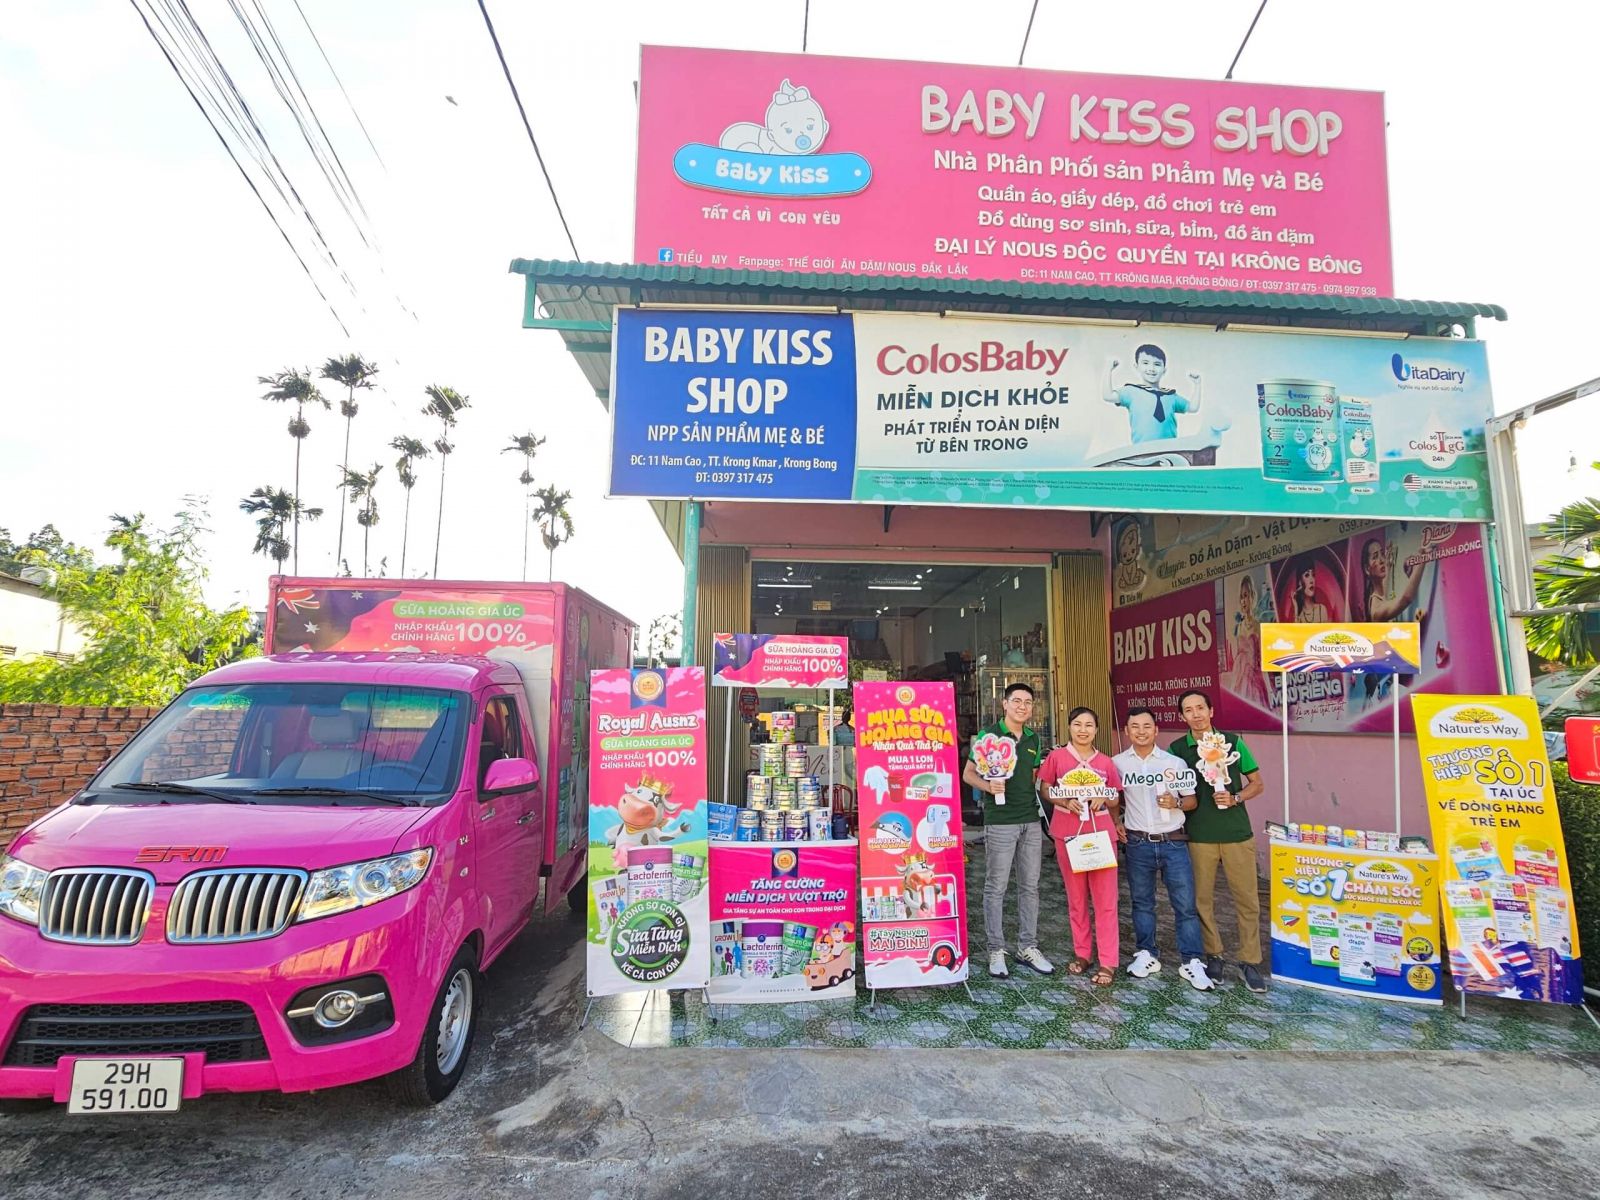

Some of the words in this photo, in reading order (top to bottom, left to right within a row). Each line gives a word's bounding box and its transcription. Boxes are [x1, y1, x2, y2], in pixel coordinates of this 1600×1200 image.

[921, 85, 1045, 140] BABY
[1070, 94, 1195, 149] KISS
[1214, 106, 1343, 157] SHOP
[716, 158, 772, 185] Baby
[780, 164, 829, 184] Kiss
[934, 150, 977, 171] Nhà
[987, 152, 1043, 175] Phân
[1051, 155, 1098, 178] Phối
[1104, 159, 1143, 181] sản
[1152, 161, 1215, 185] Phẩm
[1223, 167, 1255, 193] Mẹ
[1261, 171, 1286, 190] và
[1294, 172, 1323, 192] Bé
[978, 184, 1025, 203] Quần
[1031, 188, 1057, 206] áo,
[1102, 191, 1138, 211] dép,
[1144, 193, 1167, 210] đồ
[1173, 198, 1213, 213] chơi
[1220, 199, 1244, 215] trẻ
[1250, 204, 1276, 217] em
[702, 206, 728, 220] TẤT
[732, 205, 750, 221] CẢ
[757, 208, 771, 222] VÌ
[779, 213, 806, 224] CON
[812, 211, 840, 225] YÊU
[978, 210, 1004, 226] Đồ
[1010, 213, 1054, 233] dùng
[1059, 219, 1084, 231] sơ
[1089, 219, 1131, 235] sinh,
[1136, 220, 1175, 238] sữa,
[1180, 220, 1218, 240] bỉm,
[1250, 227, 1273, 242] ăn
[1277, 230, 1315, 247] dặm
[739, 256, 784, 269] Fanpage:
[934, 237, 968, 257] ĐẠI
[974, 236, 996, 255] LÝ
[1003, 241, 1057, 258] NOUS
[1063, 240, 1107, 264] ĐỘC
[1116, 244, 1187, 265] QUYỀN
[1194, 251, 1225, 270] TẠI
[1231, 252, 1300, 272] KRÔNG
[1308, 255, 1363, 275] BÔNG
[1051, 270, 1072, 279] NAM
[1075, 271, 1097, 282] CAO,
[1099, 272, 1111, 281] TT
[1285, 281, 1300, 291] 317
[1302, 282, 1317, 292] 475
[1324, 284, 1343, 293] 0974
[1345, 285, 1360, 295] 997
[644, 326, 744, 364] BABY
[753, 329, 832, 366] KISS
[877, 340, 1069, 376] ColosBaby
[687, 377, 787, 414] SHOP
[877, 384, 932, 410] MIỄN
[941, 389, 999, 412] DỊCH
[1008, 381, 1069, 406] KHỎE
[1266, 403, 1333, 420] ColosBaby
[884, 419, 924, 436] PHÁT
[930, 414, 971, 434] TRIỂN
[977, 417, 1019, 432] TOÀN
[1025, 415, 1059, 433] DIỆN
[648, 425, 678, 441] NPP
[682, 421, 711, 442] SẢN
[716, 421, 760, 443] PHẨM
[764, 427, 786, 447] MẸ
[790, 428, 802, 444] &
[806, 425, 825, 444] BÉ
[916, 437, 935, 454] TỪ
[940, 437, 968, 453] BÊN
[974, 437, 1028, 451] TRONG
[631, 455, 645, 465] ĐC:
[648, 455, 658, 466] 11
[661, 456, 683, 466] Nam
[708, 456, 720, 466] TT.
[723, 456, 750, 469] Krong
[784, 458, 811, 470] Krong
[813, 458, 837, 470] Bong
[696, 472, 710, 482] ĐT:
[712, 472, 735, 482] 0397
[737, 473, 754, 483] 317
[756, 473, 773, 483] 475
[1422, 523, 1450, 547] Diana
[478, 607, 500, 616] GIA
[503, 605, 520, 617] ÚC
[455, 623, 526, 642] 100%
[1114, 623, 1156, 665] BABY
[1162, 609, 1212, 657] KISS
[1310, 644, 1345, 653] Nature's
[802, 658, 843, 673] 100%
[599, 714, 646, 734] Royal
[1439, 724, 1489, 734] Nature's
[646, 751, 696, 767] 100%
[1427, 745, 1493, 768] THƯƠNG
[1474, 749, 1523, 785] SỐ
[1529, 761, 1544, 787] 1
[1434, 763, 1471, 781] HIỆU
[1050, 787, 1091, 797] Nature's
[1169, 781, 1195, 789] GROUP
[1489, 788, 1513, 800] TẠI
[1517, 786, 1536, 799] ÚC
[1439, 798, 1456, 810] VỀ
[1460, 800, 1502, 812] DÒNG
[1506, 802, 1544, 814] HÀNG
[1470, 814, 1496, 827] TRẺ
[1501, 819, 1521, 828] EM
[134, 846, 229, 862] SRM
[628, 870, 672, 880] Lactoferrin
[1359, 871, 1390, 880] Nature's
[757, 893, 786, 904] DỊCH
[1392, 884, 1421, 898] SÓC
[651, 926, 683, 942] Tăng
[658, 941, 681, 954] Dịch
[742, 943, 783, 951] Lactoferrin
[104, 1063, 151, 1084] 29H
[82, 1088, 167, 1110] 591.00
